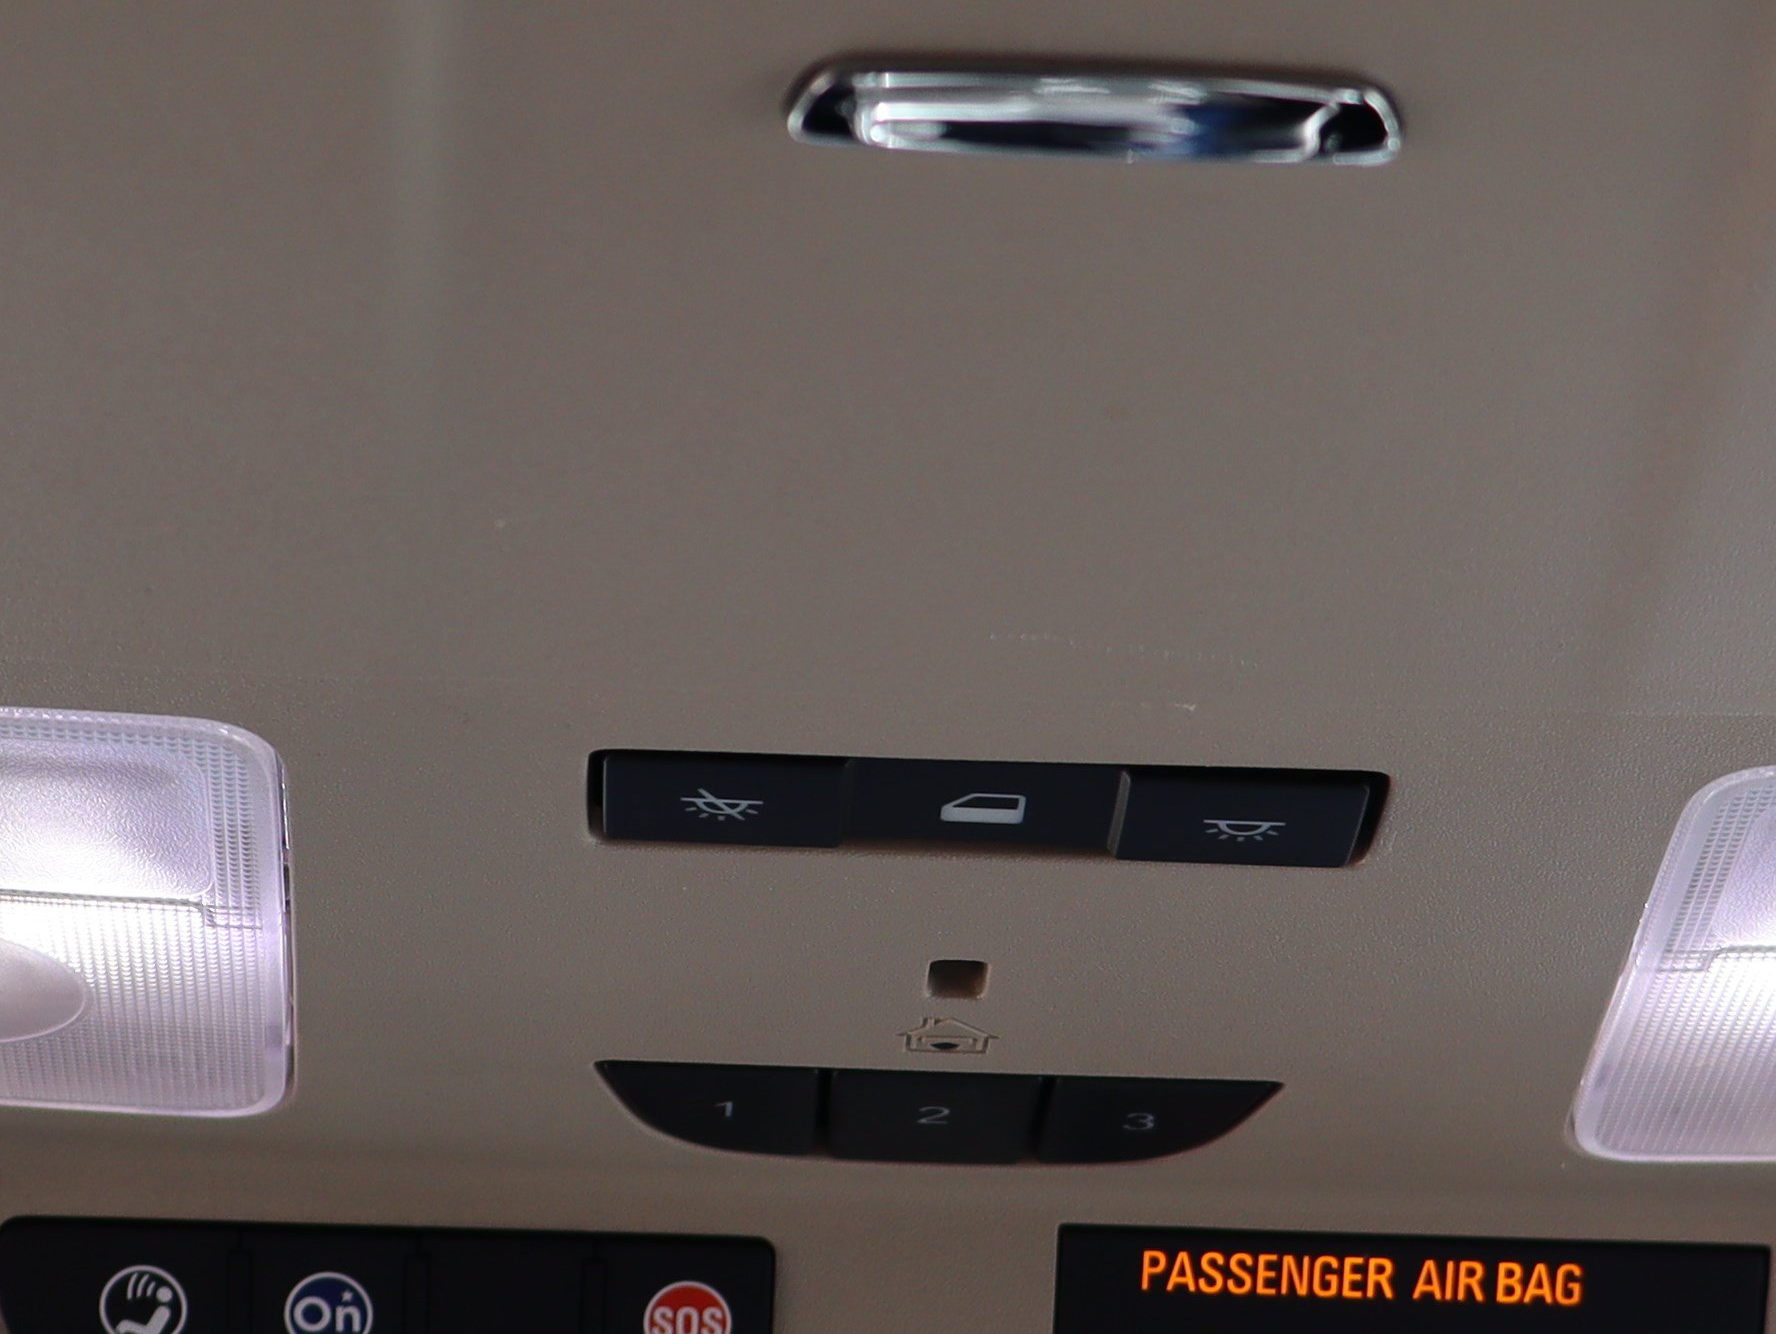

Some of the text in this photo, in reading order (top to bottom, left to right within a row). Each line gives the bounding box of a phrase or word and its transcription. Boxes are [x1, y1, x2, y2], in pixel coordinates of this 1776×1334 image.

[714, 1100, 1155, 1131] 1 2 3
[1140, 1249, 1584, 1307] PASSENGER AIR BAG
[292, 1293, 363, 1334] On
